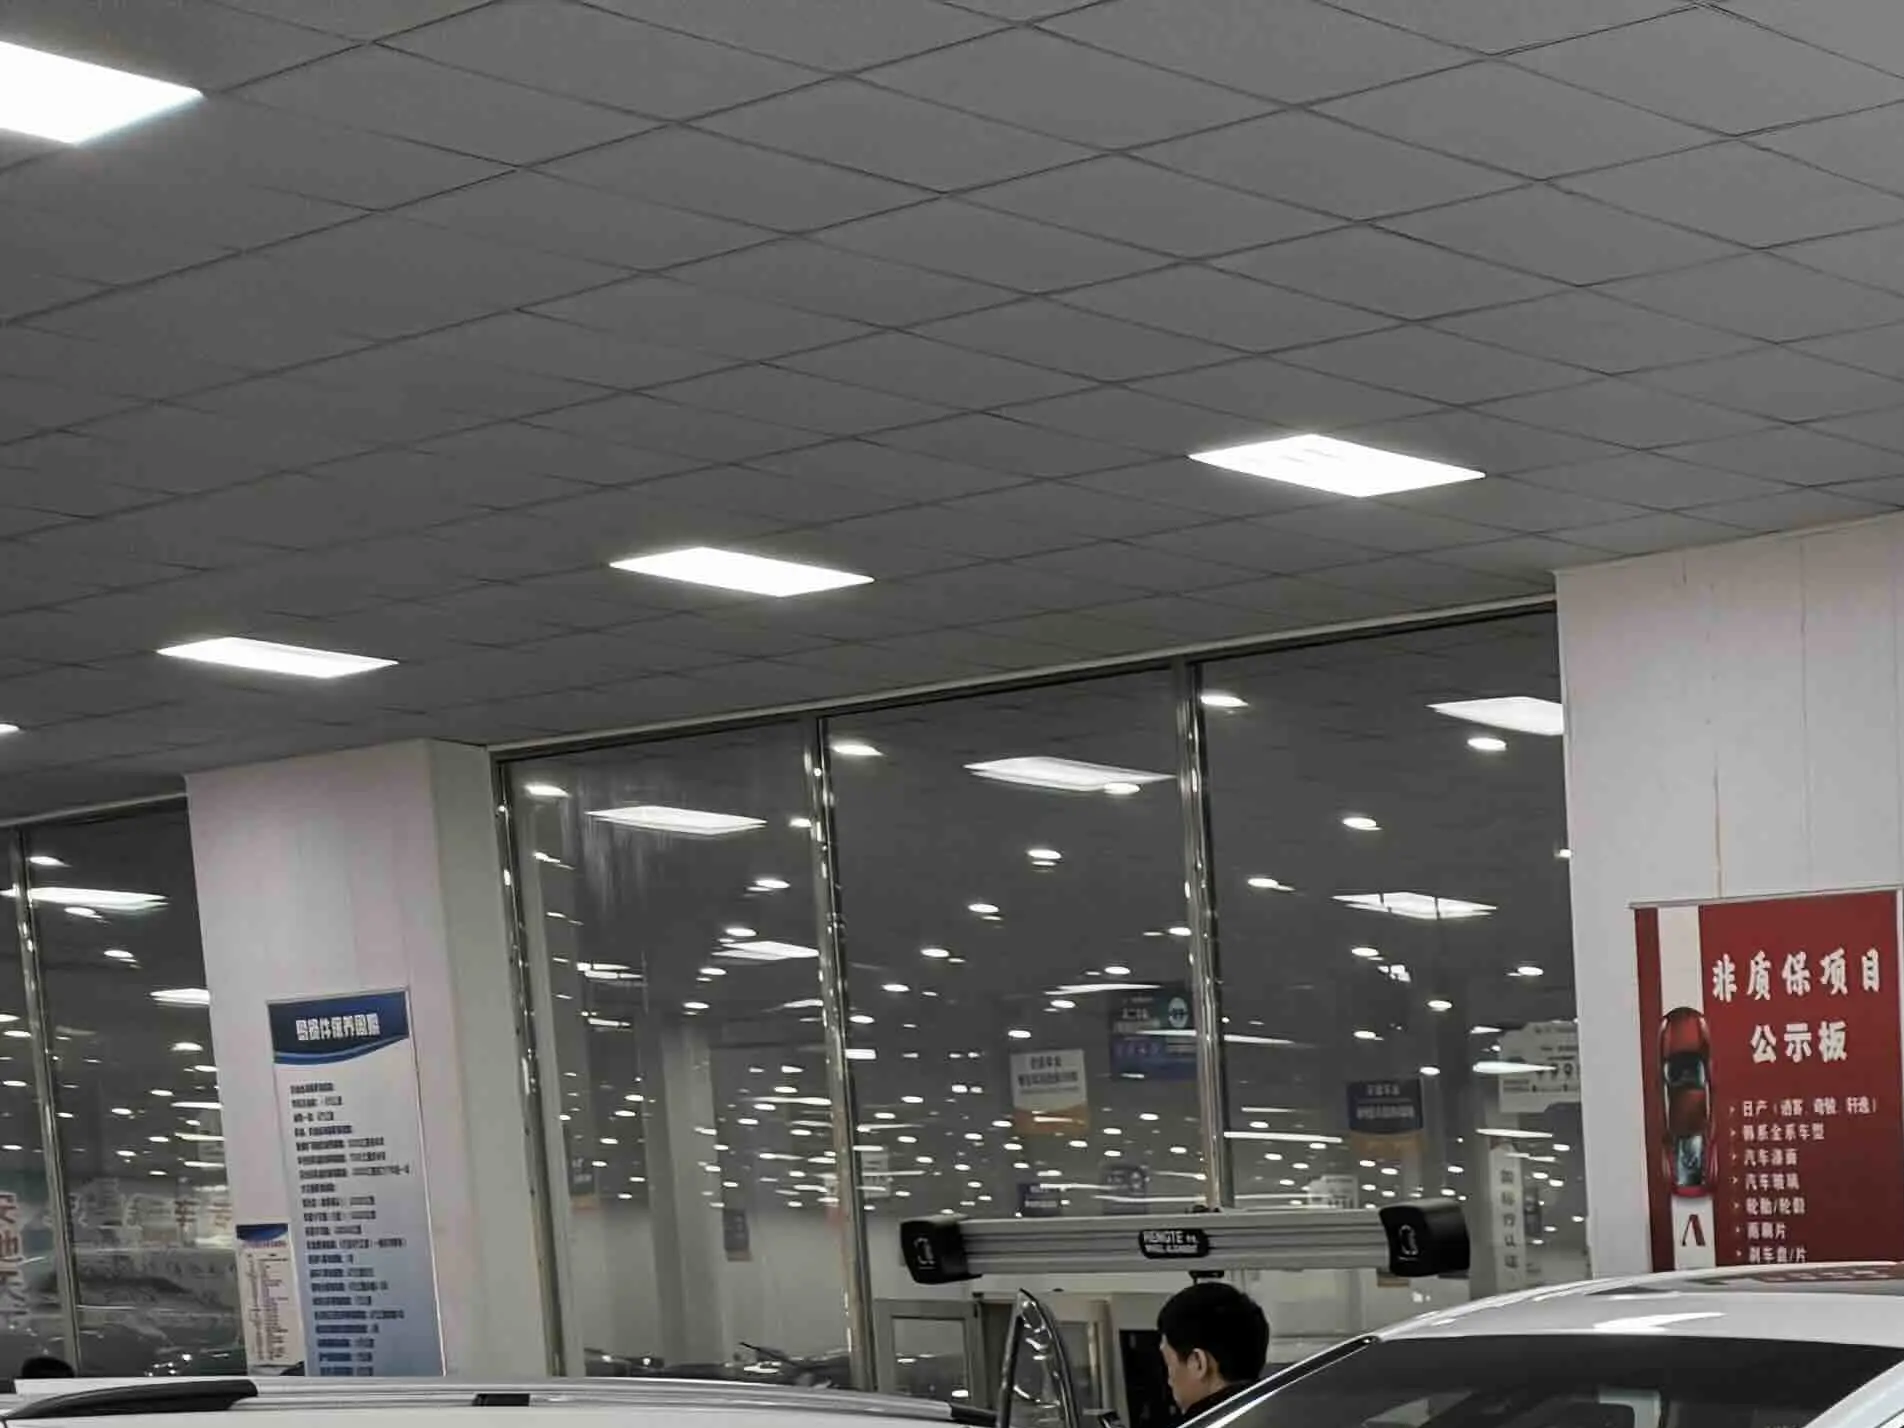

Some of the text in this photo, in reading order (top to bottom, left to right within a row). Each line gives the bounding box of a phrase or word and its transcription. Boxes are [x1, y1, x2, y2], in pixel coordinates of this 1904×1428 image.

[1712, 946, 1881, 1003] 非质保项目
[1750, 1019, 1848, 1064] 公示板
